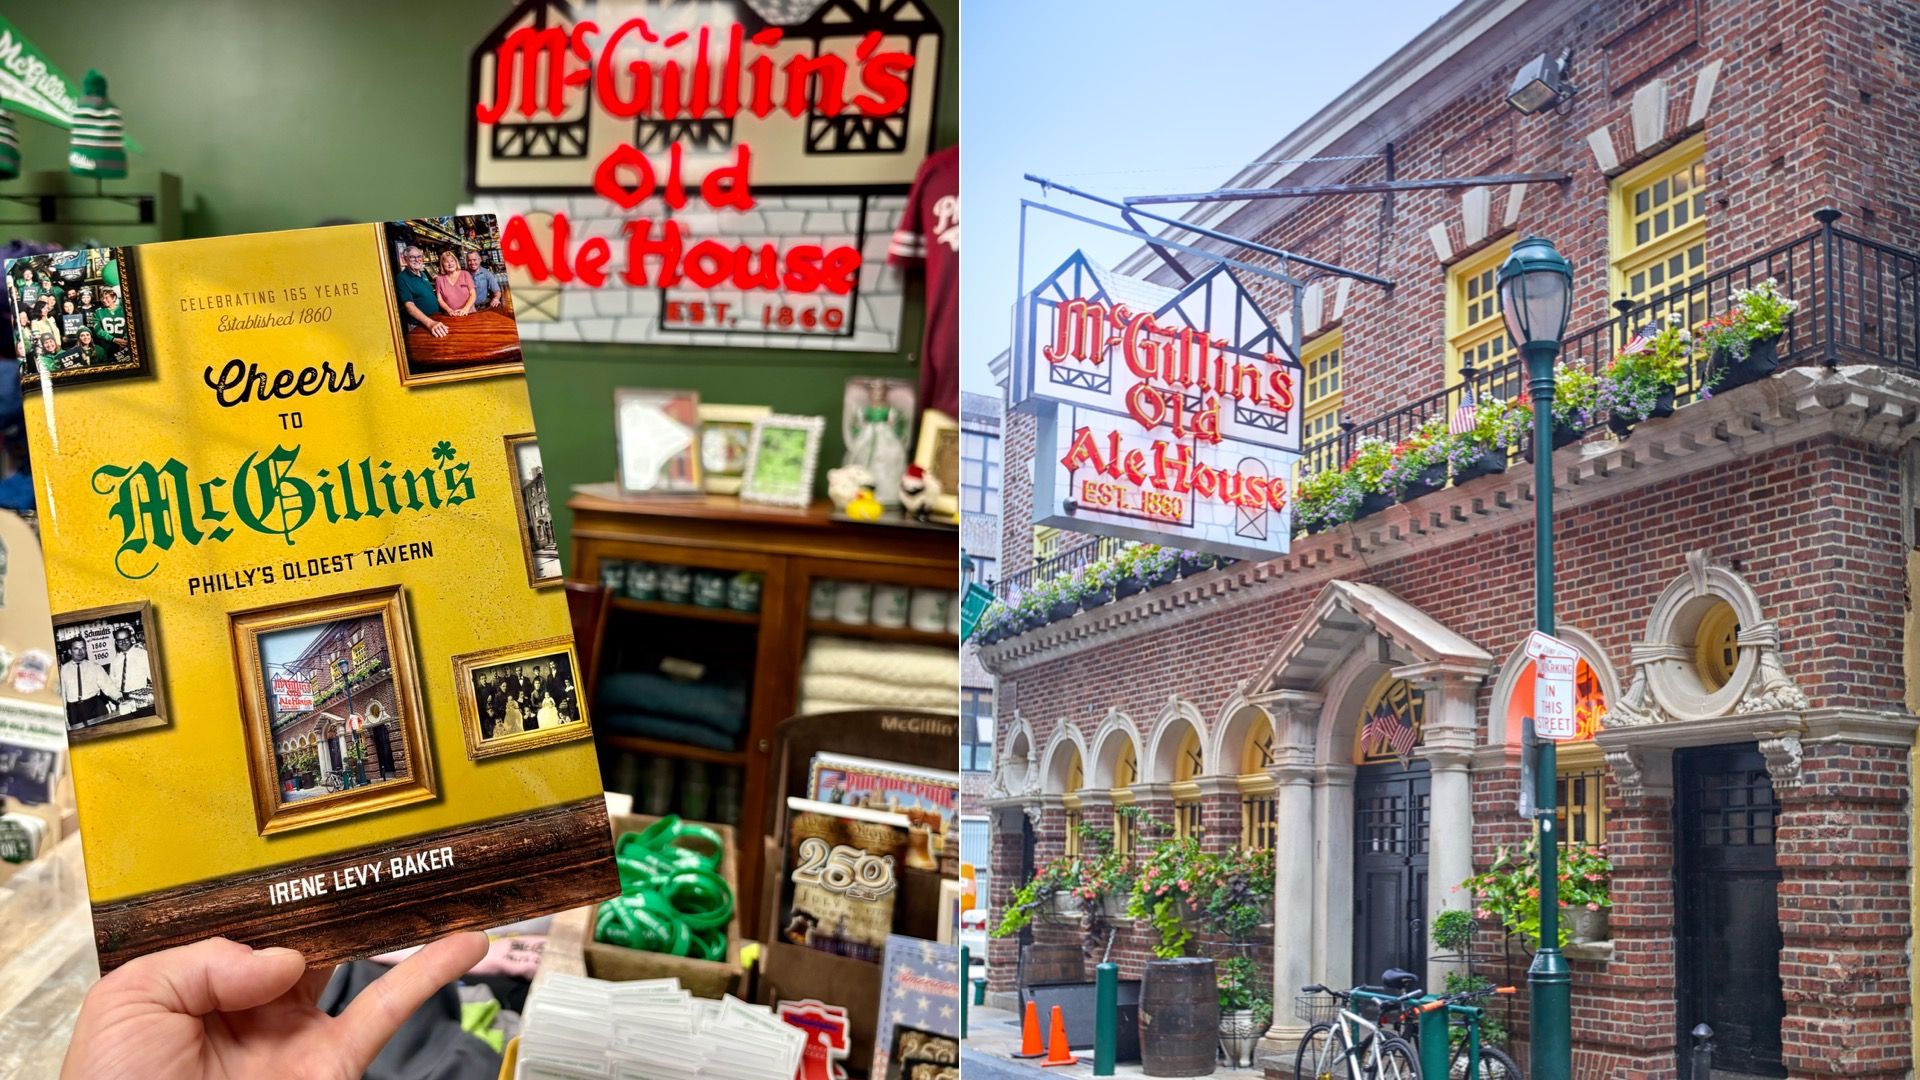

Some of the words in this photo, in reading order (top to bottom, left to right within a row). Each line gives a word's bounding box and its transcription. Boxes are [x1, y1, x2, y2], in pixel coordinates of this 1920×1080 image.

[475, 17, 916, 125] McGillin's
[593, 141, 757, 212] Old
[180, 290, 276, 312] CELEBRATING
[284, 287, 307, 302] 165
[314, 282, 359, 299] YEARS
[762, 304, 845, 330] 1860
[102, 317, 126, 335] 62
[217, 311, 295, 333] Established
[299, 306, 333, 324] 1860
[1043, 297, 1295, 412] McGillin's
[204, 359, 365, 407] Cheers
[278, 412, 303, 430] TO
[1126, 382, 1223, 444] Old
[92, 441, 476, 580] McGillin's
[1082, 480, 1133, 510] EST.
[1142, 491, 1185, 520] 1860
[188, 566, 275, 596] PHILLY'S
[283, 553, 354, 580] OLDEST
[364, 541, 434, 567] TAVERN
[1542, 701, 1562, 714] THIS
[1545, 685, 1556, 697] IN
[1537, 717, 1571, 731] STREET
[269, 873, 327, 906] IRENE
[333, 862, 382, 892] LEVY
[390, 847, 454, 880] BAKER
[792, 838, 893, 893] 250
